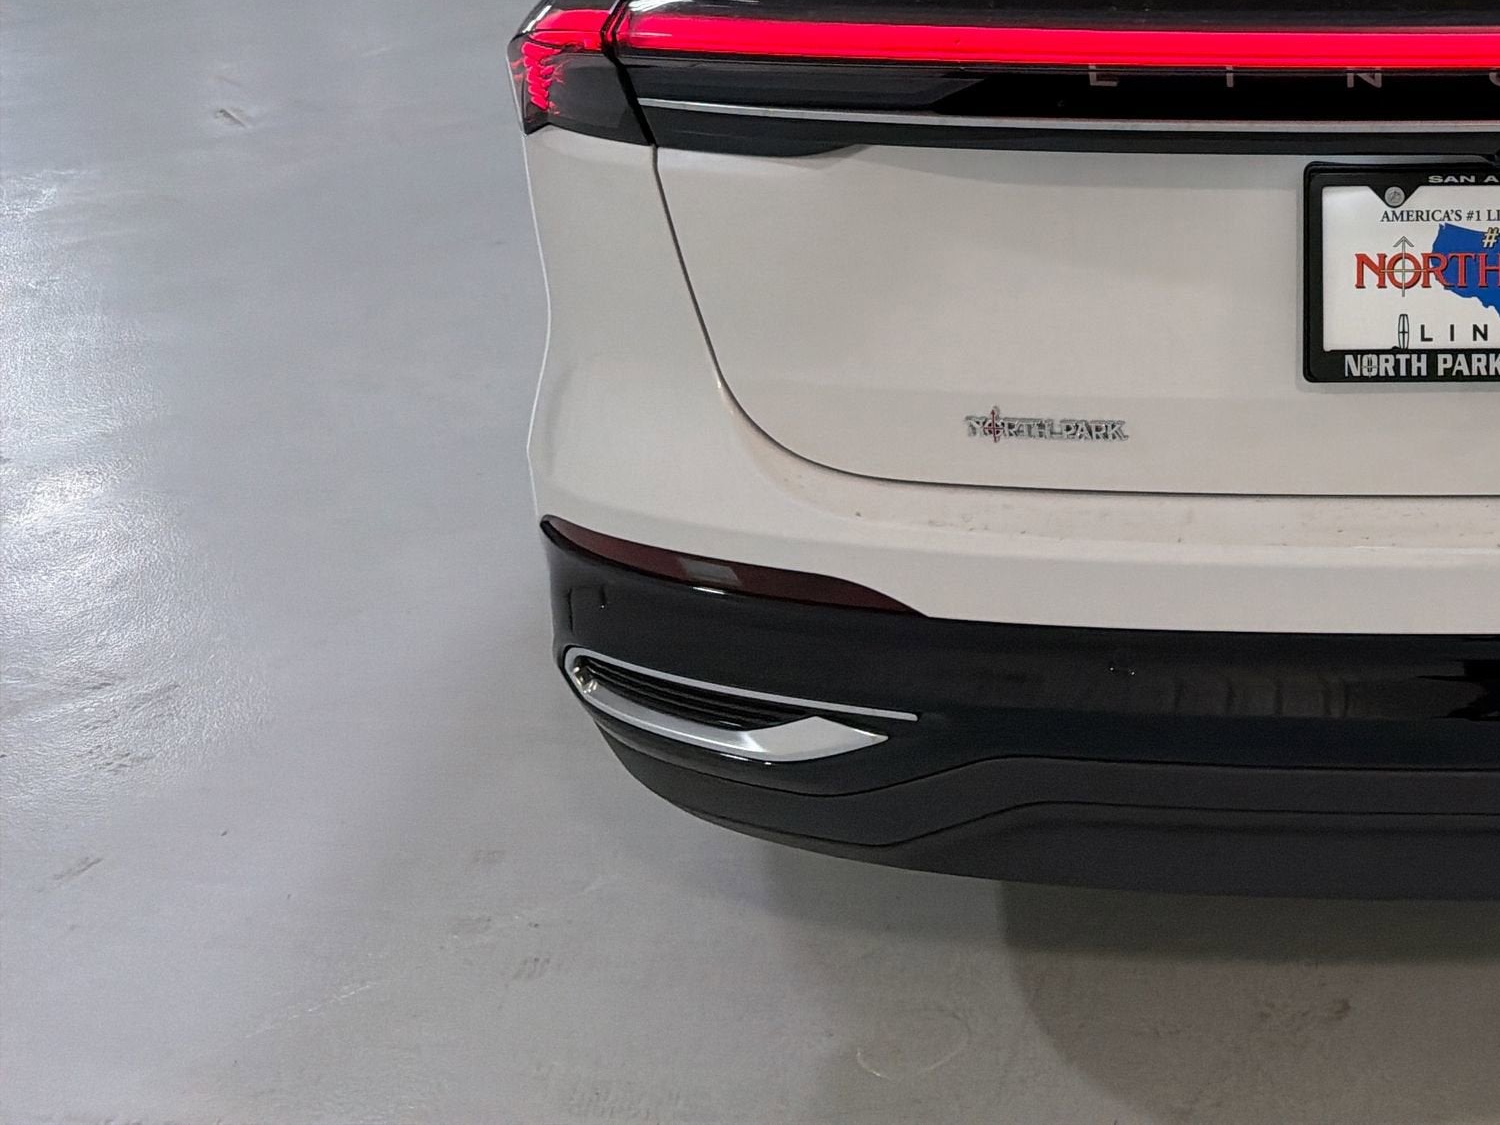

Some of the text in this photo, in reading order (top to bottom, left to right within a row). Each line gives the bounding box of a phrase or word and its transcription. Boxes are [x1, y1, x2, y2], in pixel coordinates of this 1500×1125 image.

[1428, 175, 1476, 184] SAN
[1380, 209, 1462, 223] AMERICA'S
[1466, 210, 1482, 222] #1
[1344, 353, 1428, 378] NORTH
